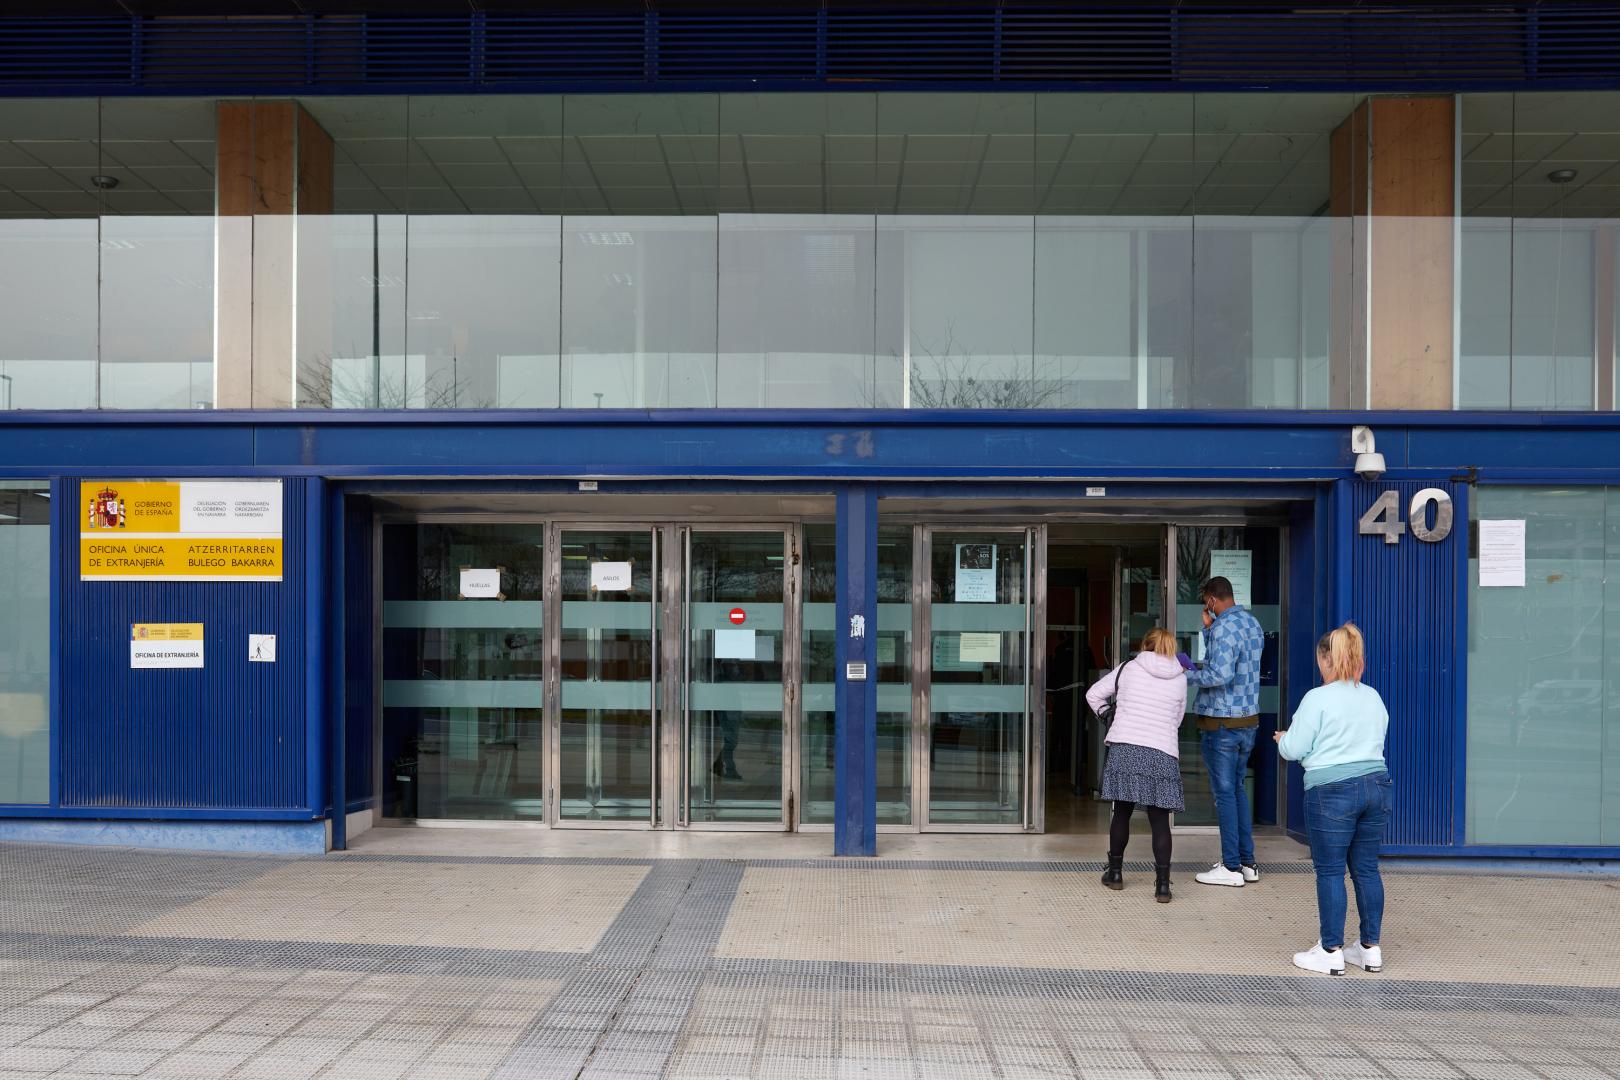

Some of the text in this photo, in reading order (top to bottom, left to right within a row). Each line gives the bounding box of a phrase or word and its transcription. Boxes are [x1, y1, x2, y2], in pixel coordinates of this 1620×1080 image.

[146, 508, 173, 516] ESPAÑA
[1359, 487, 1454, 544] 40
[88, 544, 165, 554] OFICINA ÚNICA
[188, 545, 275, 554] ATZERRITARREN
[88, 557, 165, 569] DE EXTRANJERÍA
[188, 558, 275, 567] BULEGO BAKARRA
[164, 651, 199, 659] EXTRANJERÍA
